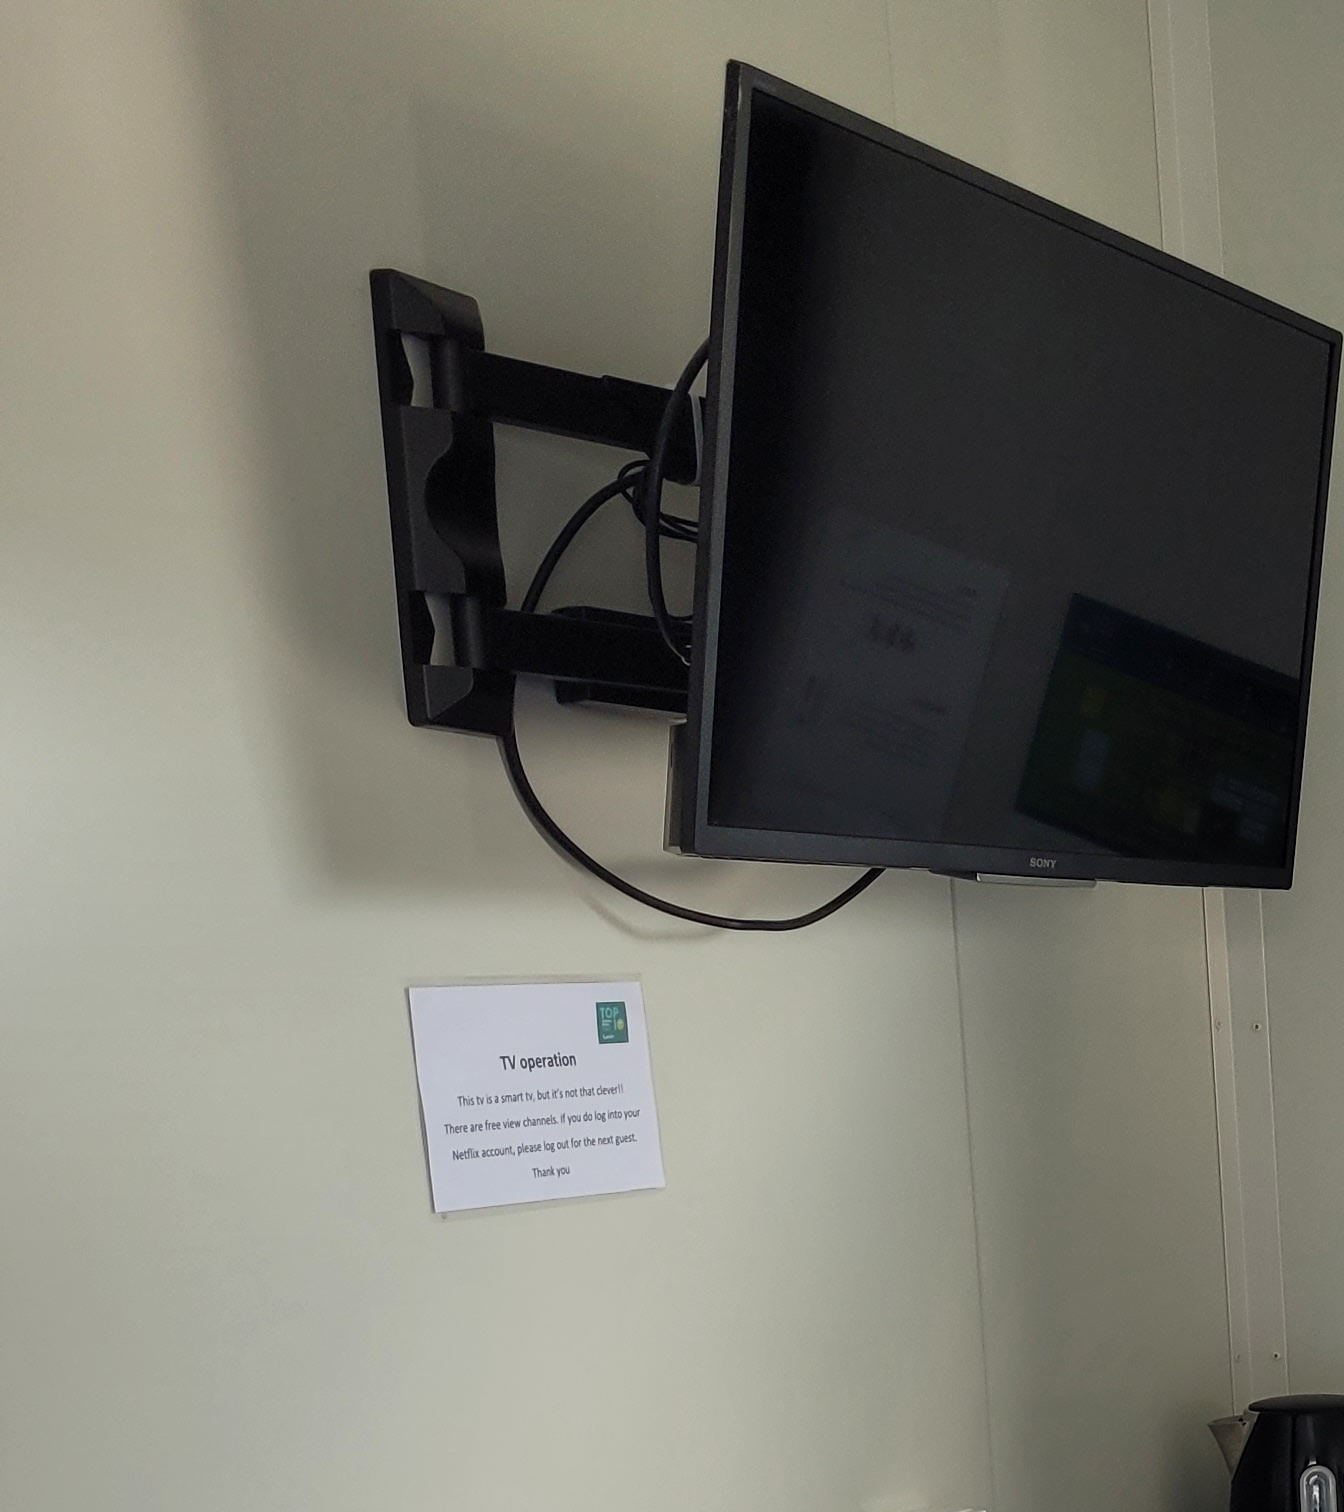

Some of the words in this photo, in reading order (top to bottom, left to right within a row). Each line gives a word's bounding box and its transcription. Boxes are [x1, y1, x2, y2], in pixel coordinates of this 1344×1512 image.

[1029, 857, 1057, 869] SONY
[600, 1007, 619, 1019] TOP
[500, 1055, 516, 1070] TV
[520, 1052, 577, 1072] operation
[457, 1095, 475, 1107] This
[476, 1096, 484, 1106] tv
[486, 1094, 493, 1105] is
[494, 1095, 500, 1104] a
[501, 1092, 524, 1104] smart
[525, 1092, 535, 1102] tv,
[537, 1089, 550, 1100] but
[551, 1088, 563, 1099] it's
[565, 1087, 578, 1099] not
[579, 1086, 595, 1097] that
[444, 1123, 468, 1135] There
[470, 1123, 483, 1133] are
[485, 1119, 501, 1131] free
[502, 1118, 521, 1129] view
[522, 1114, 559, 1128] channels.
[560, 1112, 566, 1124] If
[567, 1114, 581, 1126] you
[582, 1111, 593, 1122] do
[594, 1110, 606, 1123] log
[607, 1109, 622, 1119] into
[623, 1108, 640, 1120] your
[452, 1147, 480, 1161] Netflix
[481, 1145, 515, 1158] account,
[517, 1142, 542, 1156] please
[543, 1140, 555, 1153] log
[556, 1139, 569, 1150] out
[570, 1137, 581, 1148] for
[583, 1136, 596, 1147] the
[597, 1135, 614, 1146] next
[615, 1133, 638, 1146] guest.
[532, 1166, 555, 1179] Thank
[556, 1166, 570, 1178] you
